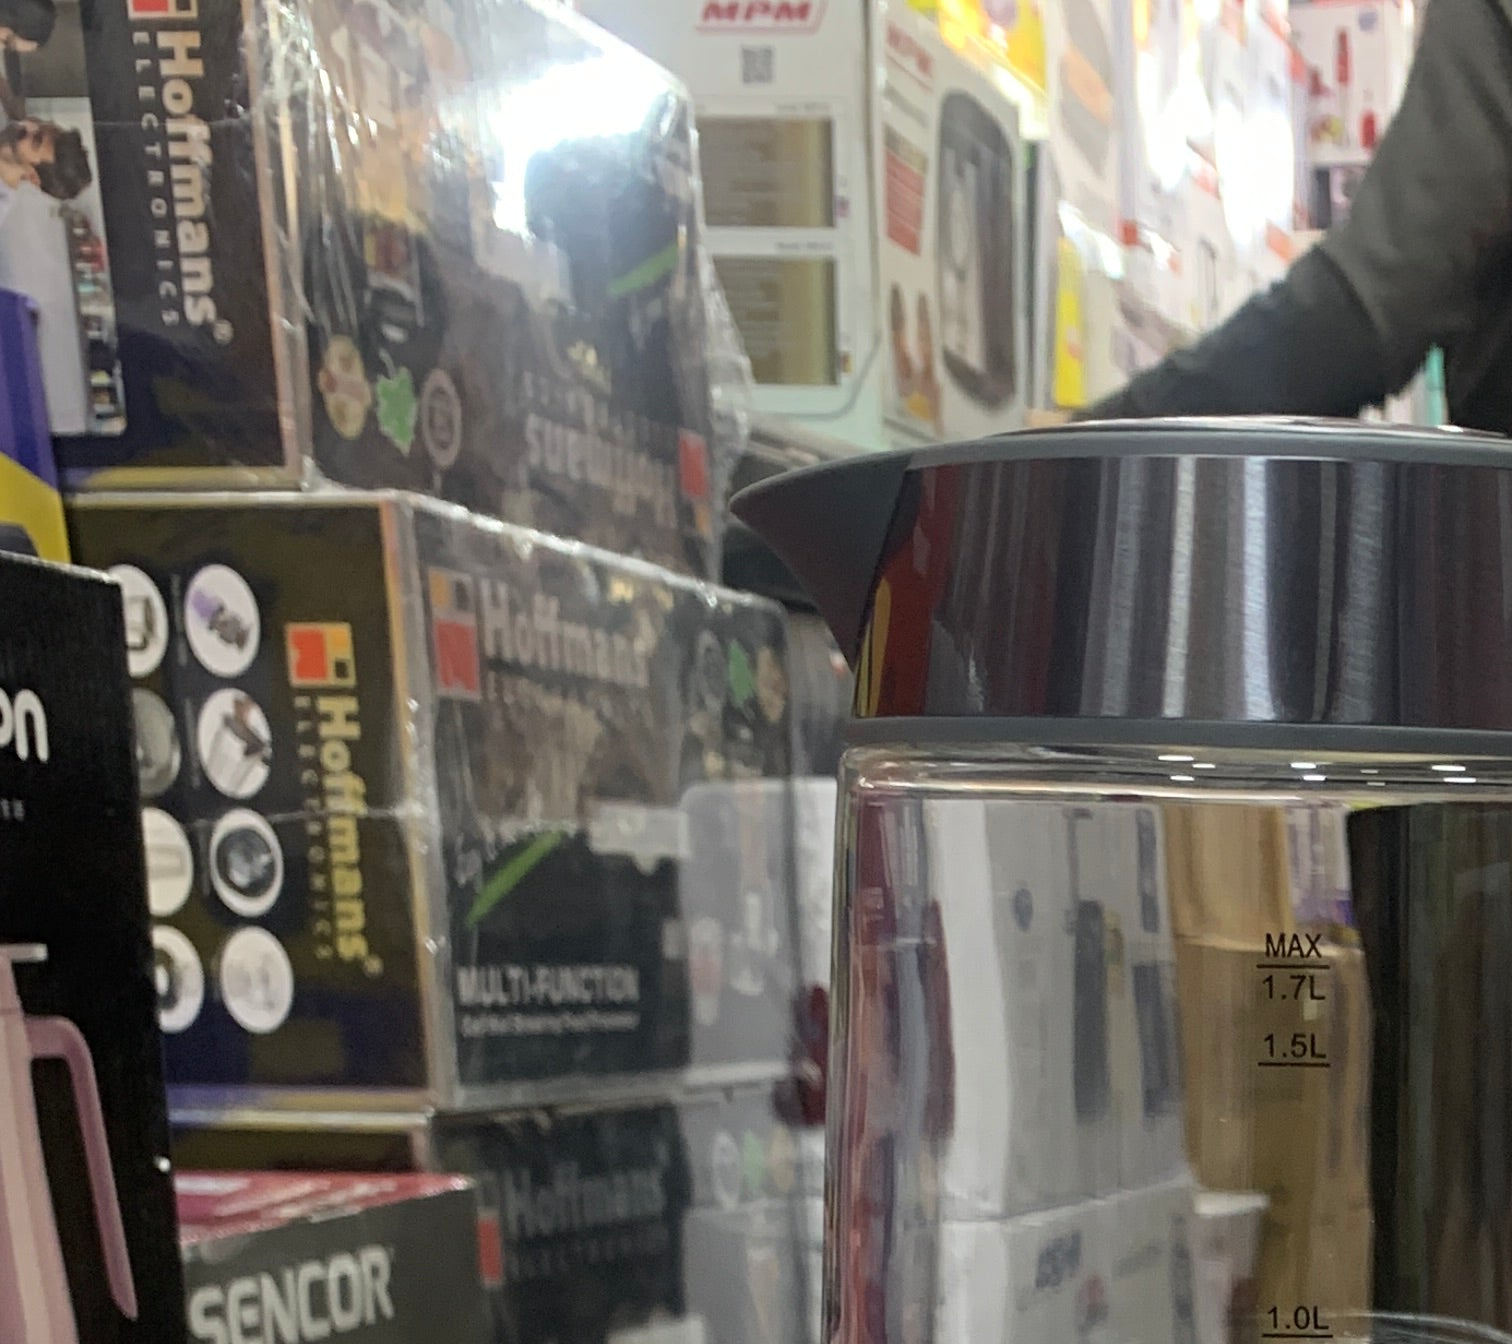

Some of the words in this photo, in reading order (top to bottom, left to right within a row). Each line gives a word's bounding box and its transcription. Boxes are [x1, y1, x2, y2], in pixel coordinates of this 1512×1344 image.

[702, 1, 810, 21] MPM
[132, 31, 179, 327] ELECTRONICS
[156, 31, 217, 326] Hoffmans
[316, 695, 369, 962] Hoffmans
[1264, 932, 1322, 958] MAX
[1262, 974, 1326, 1000] 1.7L
[1263, 1032, 1327, 1058] 1.5L
[1267, 1305, 1329, 1330] 1.0L
